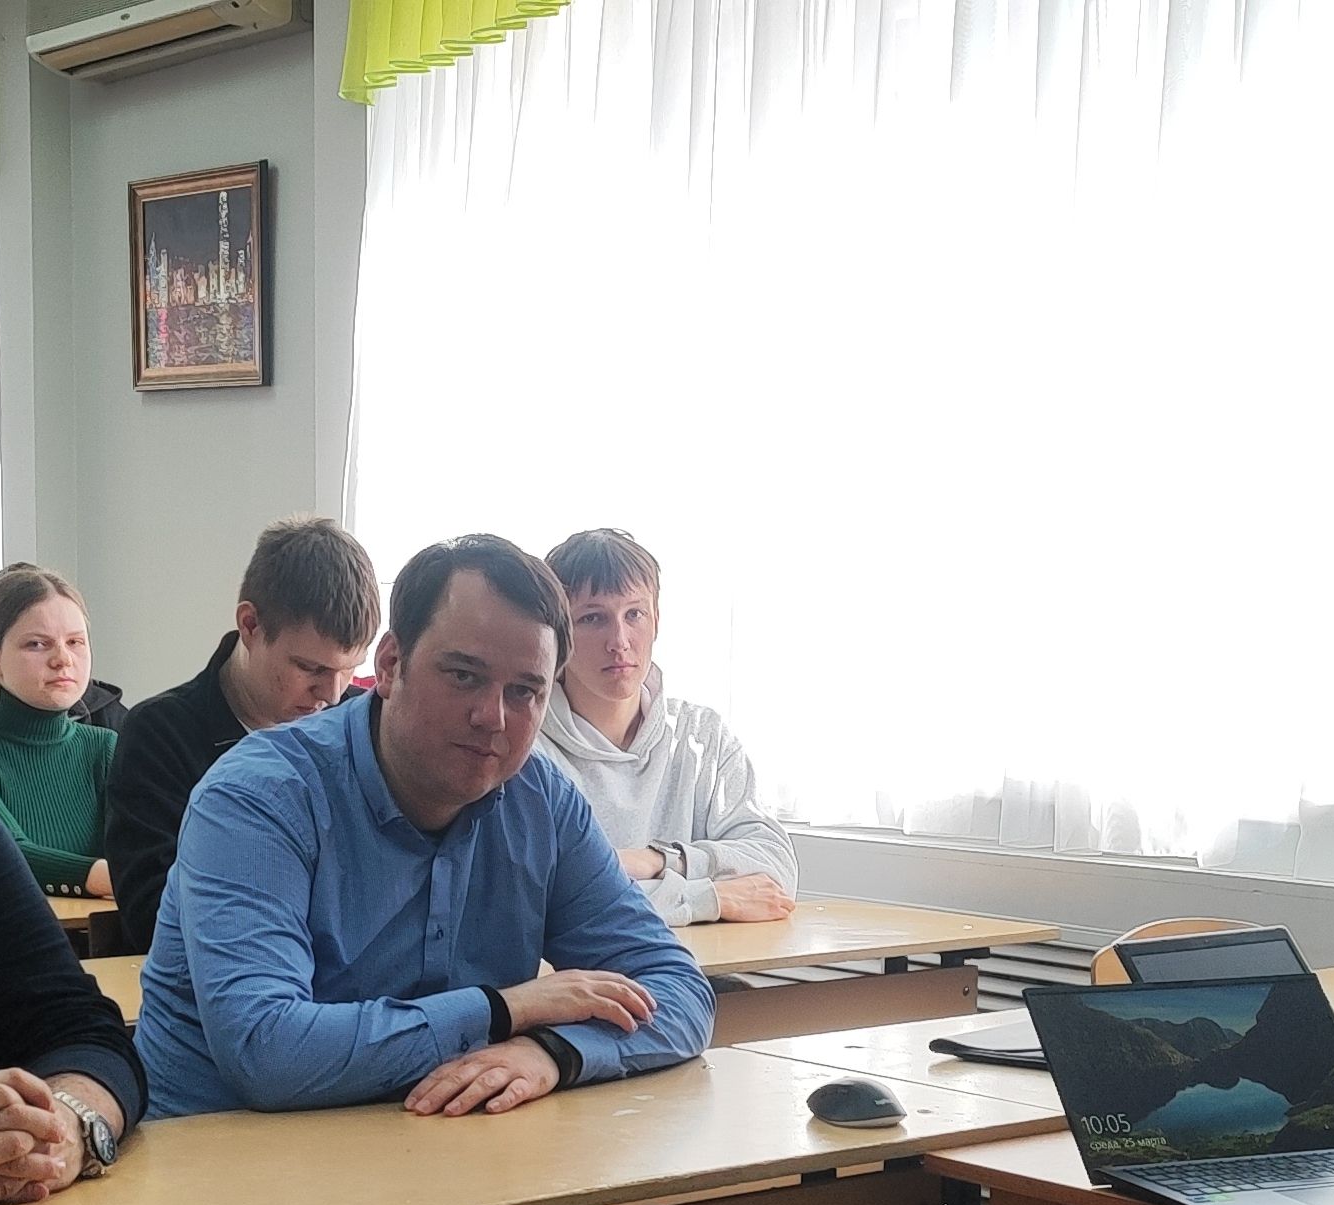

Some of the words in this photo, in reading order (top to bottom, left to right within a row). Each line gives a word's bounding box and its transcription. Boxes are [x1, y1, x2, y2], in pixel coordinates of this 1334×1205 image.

[1080, 1113, 1131, 1135] 10:05
[1123, 1137, 1136, 1148] 25
[1137, 1136, 1167, 1148] марта
